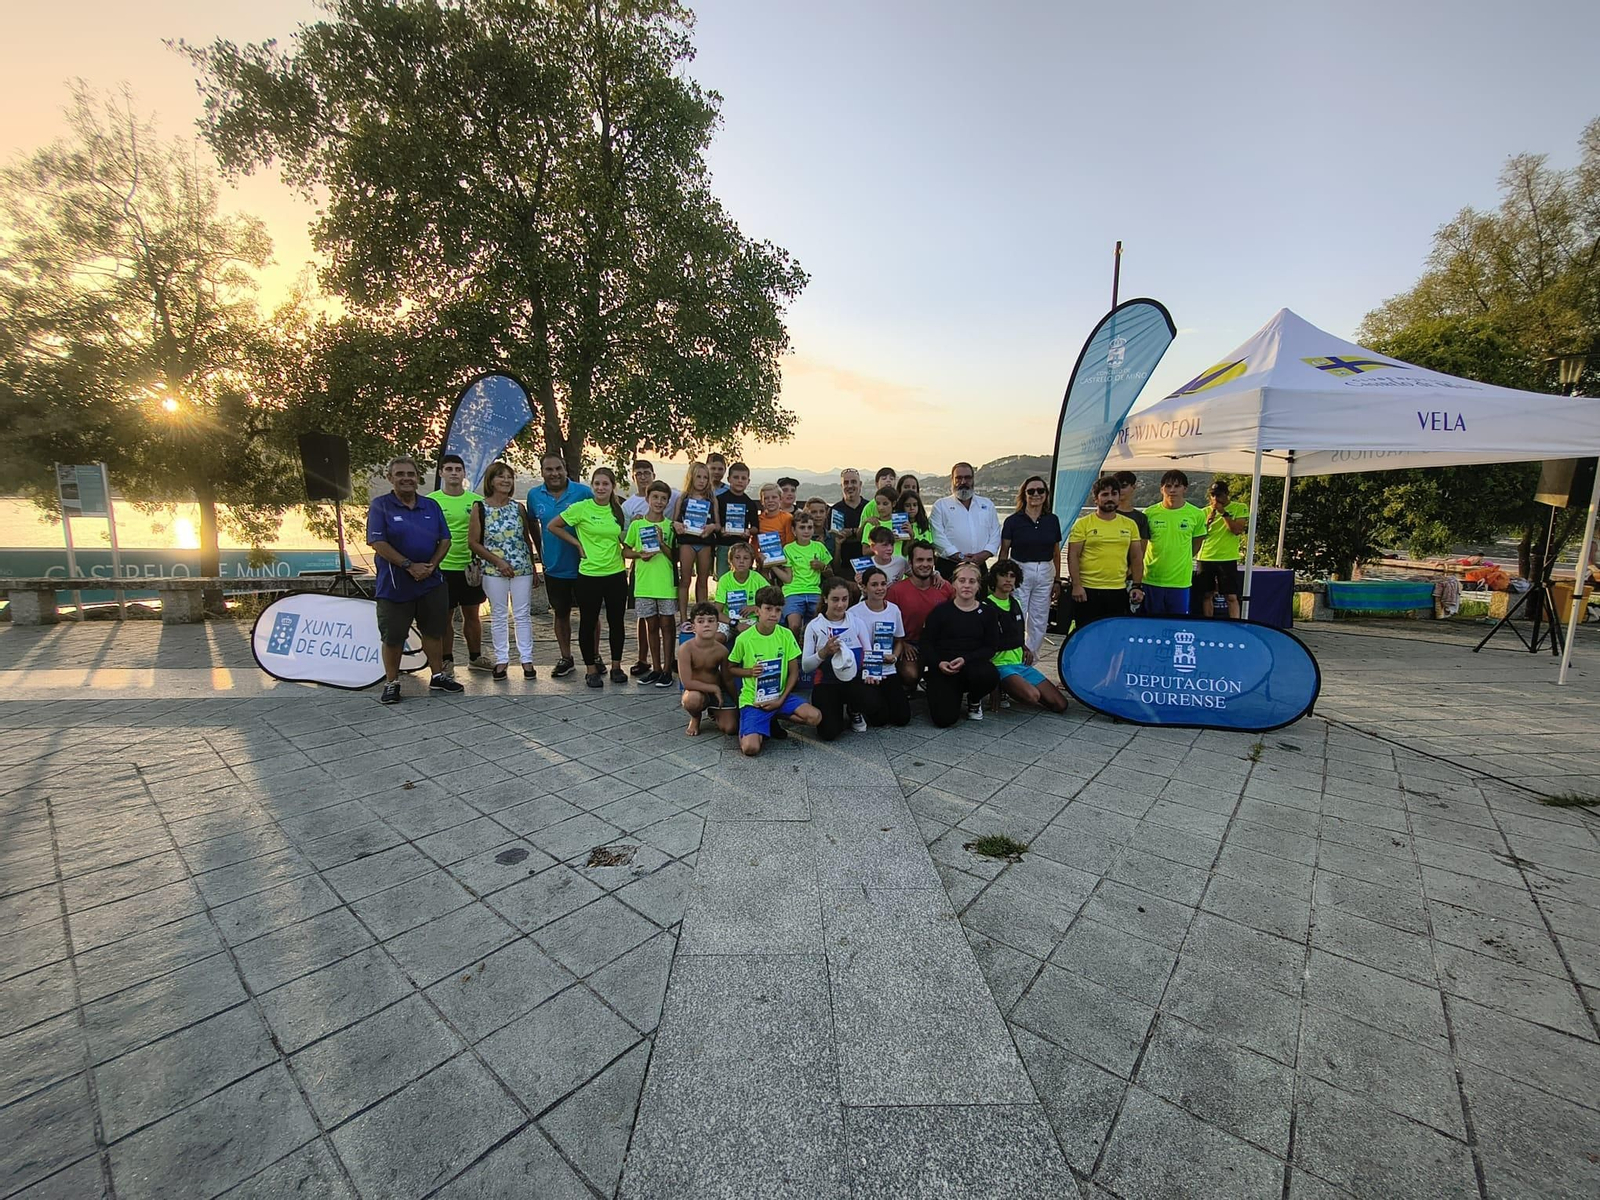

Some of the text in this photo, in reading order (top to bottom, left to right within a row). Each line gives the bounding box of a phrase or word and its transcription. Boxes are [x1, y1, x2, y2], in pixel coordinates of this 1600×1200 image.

[1114, 374, 1125, 382] DE
[1417, 411, 1467, 432] VELA
[301, 618, 353, 640] XUNTA
[295, 638, 379, 665] DE GALICIA
[1126, 673, 1243, 694] DEPUTACIÓN
[1141, 690, 1227, 709] OURENSE
